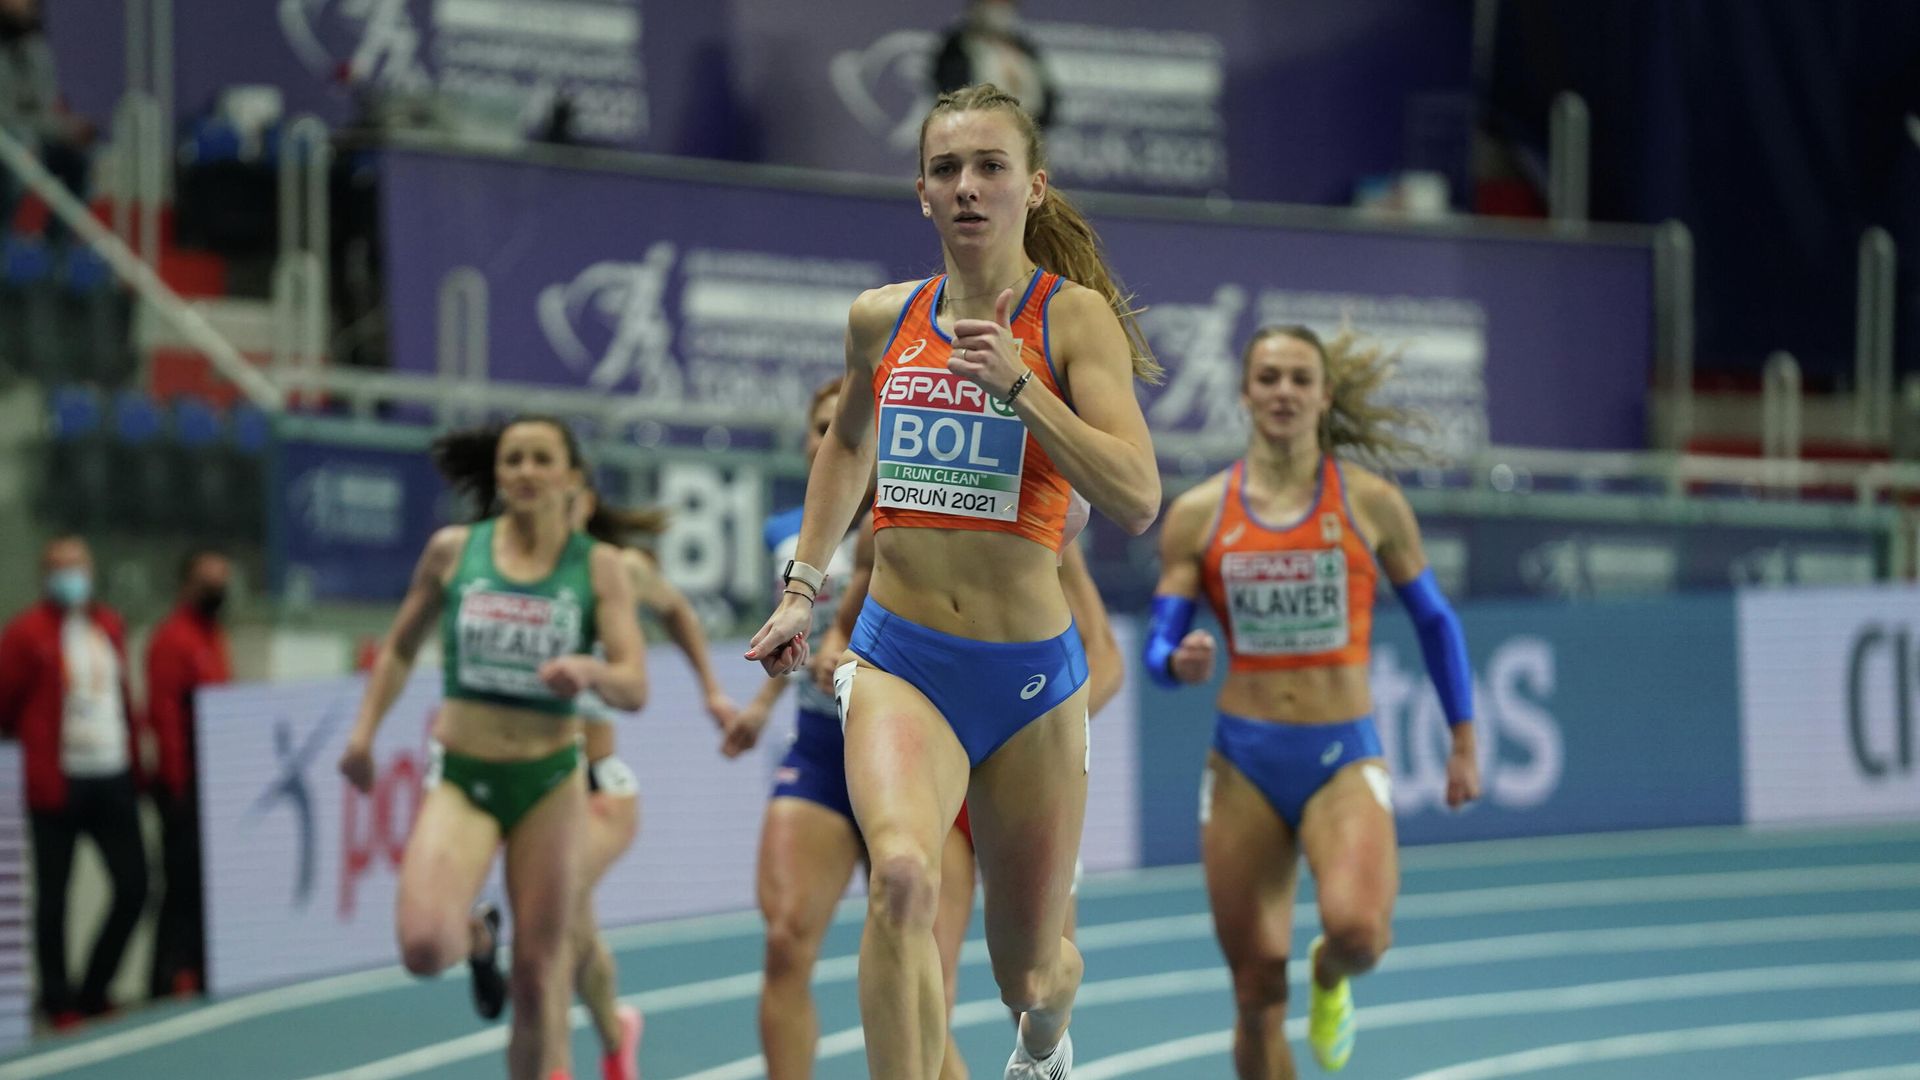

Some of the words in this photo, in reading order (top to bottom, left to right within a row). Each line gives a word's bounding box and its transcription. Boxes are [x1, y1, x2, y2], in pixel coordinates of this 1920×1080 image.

[888, 376, 983, 407] SPAR
[889, 413, 999, 467] BOL
[895, 466, 900, 478] I
[902, 467, 930, 481] RUN
[882, 485, 947, 507] TORUŃ
[951, 492, 996, 513] 2021
[1229, 554, 1312, 579] SPAR
[1232, 584, 1339, 619] KLAVER
